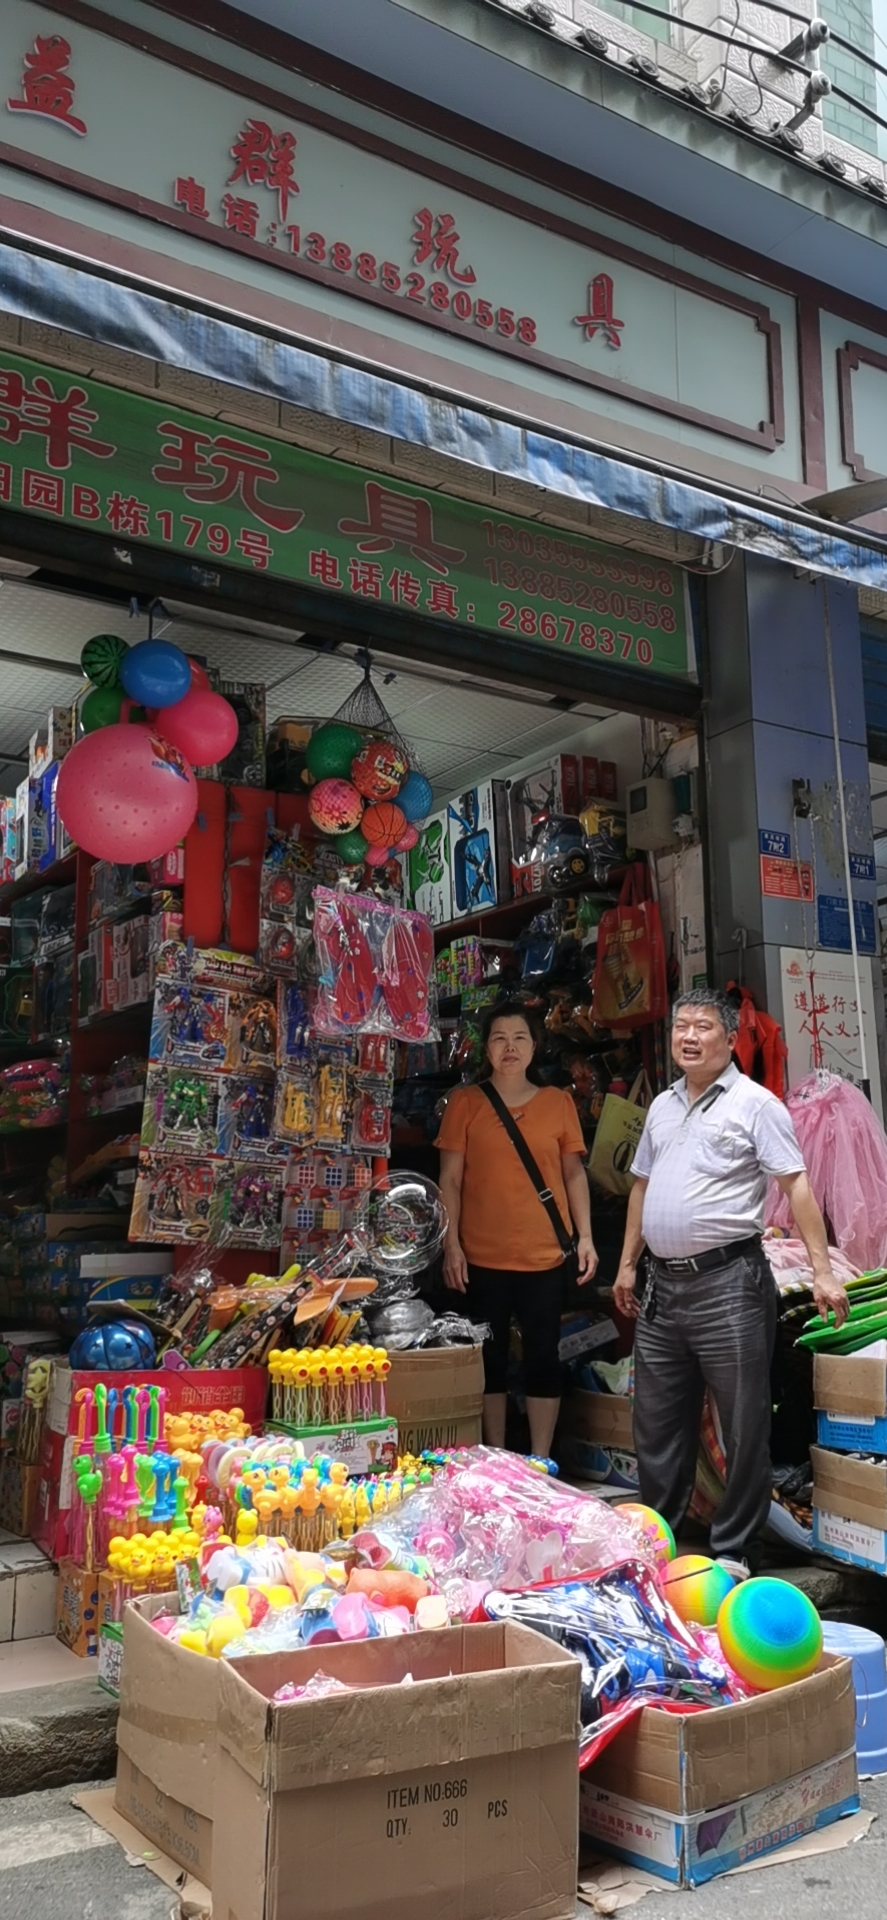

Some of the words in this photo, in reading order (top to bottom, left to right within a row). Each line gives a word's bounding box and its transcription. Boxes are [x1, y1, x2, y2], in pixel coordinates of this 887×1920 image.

[484, 557, 677, 633] 13885280558
[416, 1426, 442, 1452] WAN
[444, 1424, 457, 1449] JU
[386, 1786, 420, 1810] ITEM
[424, 1779, 468, 1803] NO:666
[386, 1820, 412, 1839] QTY:
[442, 1808, 459, 1828] 30
[487, 1800, 508, 1820] PCS
